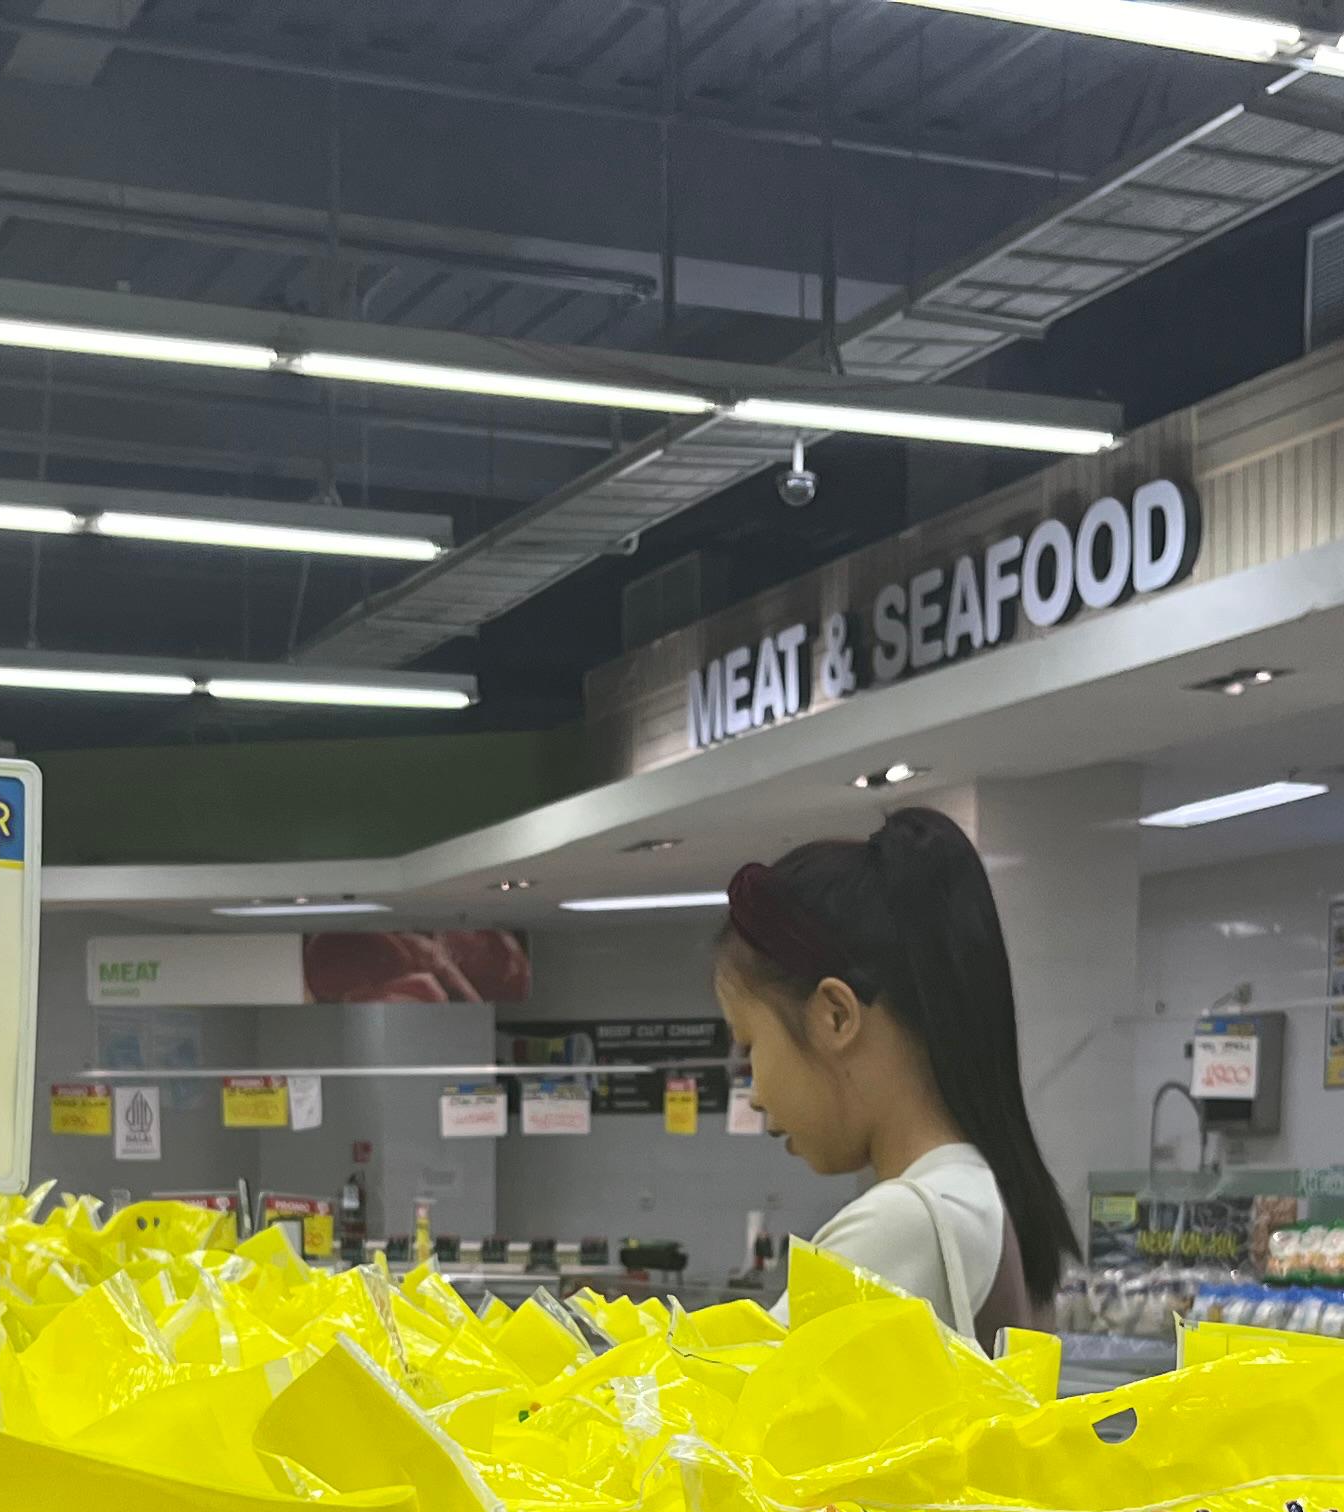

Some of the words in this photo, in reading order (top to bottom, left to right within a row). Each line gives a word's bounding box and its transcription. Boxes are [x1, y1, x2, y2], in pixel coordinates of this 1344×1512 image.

[687, 622, 807, 749] MEAT
[819, 612, 855, 699] &
[871, 478, 1188, 683] SEAFOOD
[99, 960, 160, 982] MEAT
